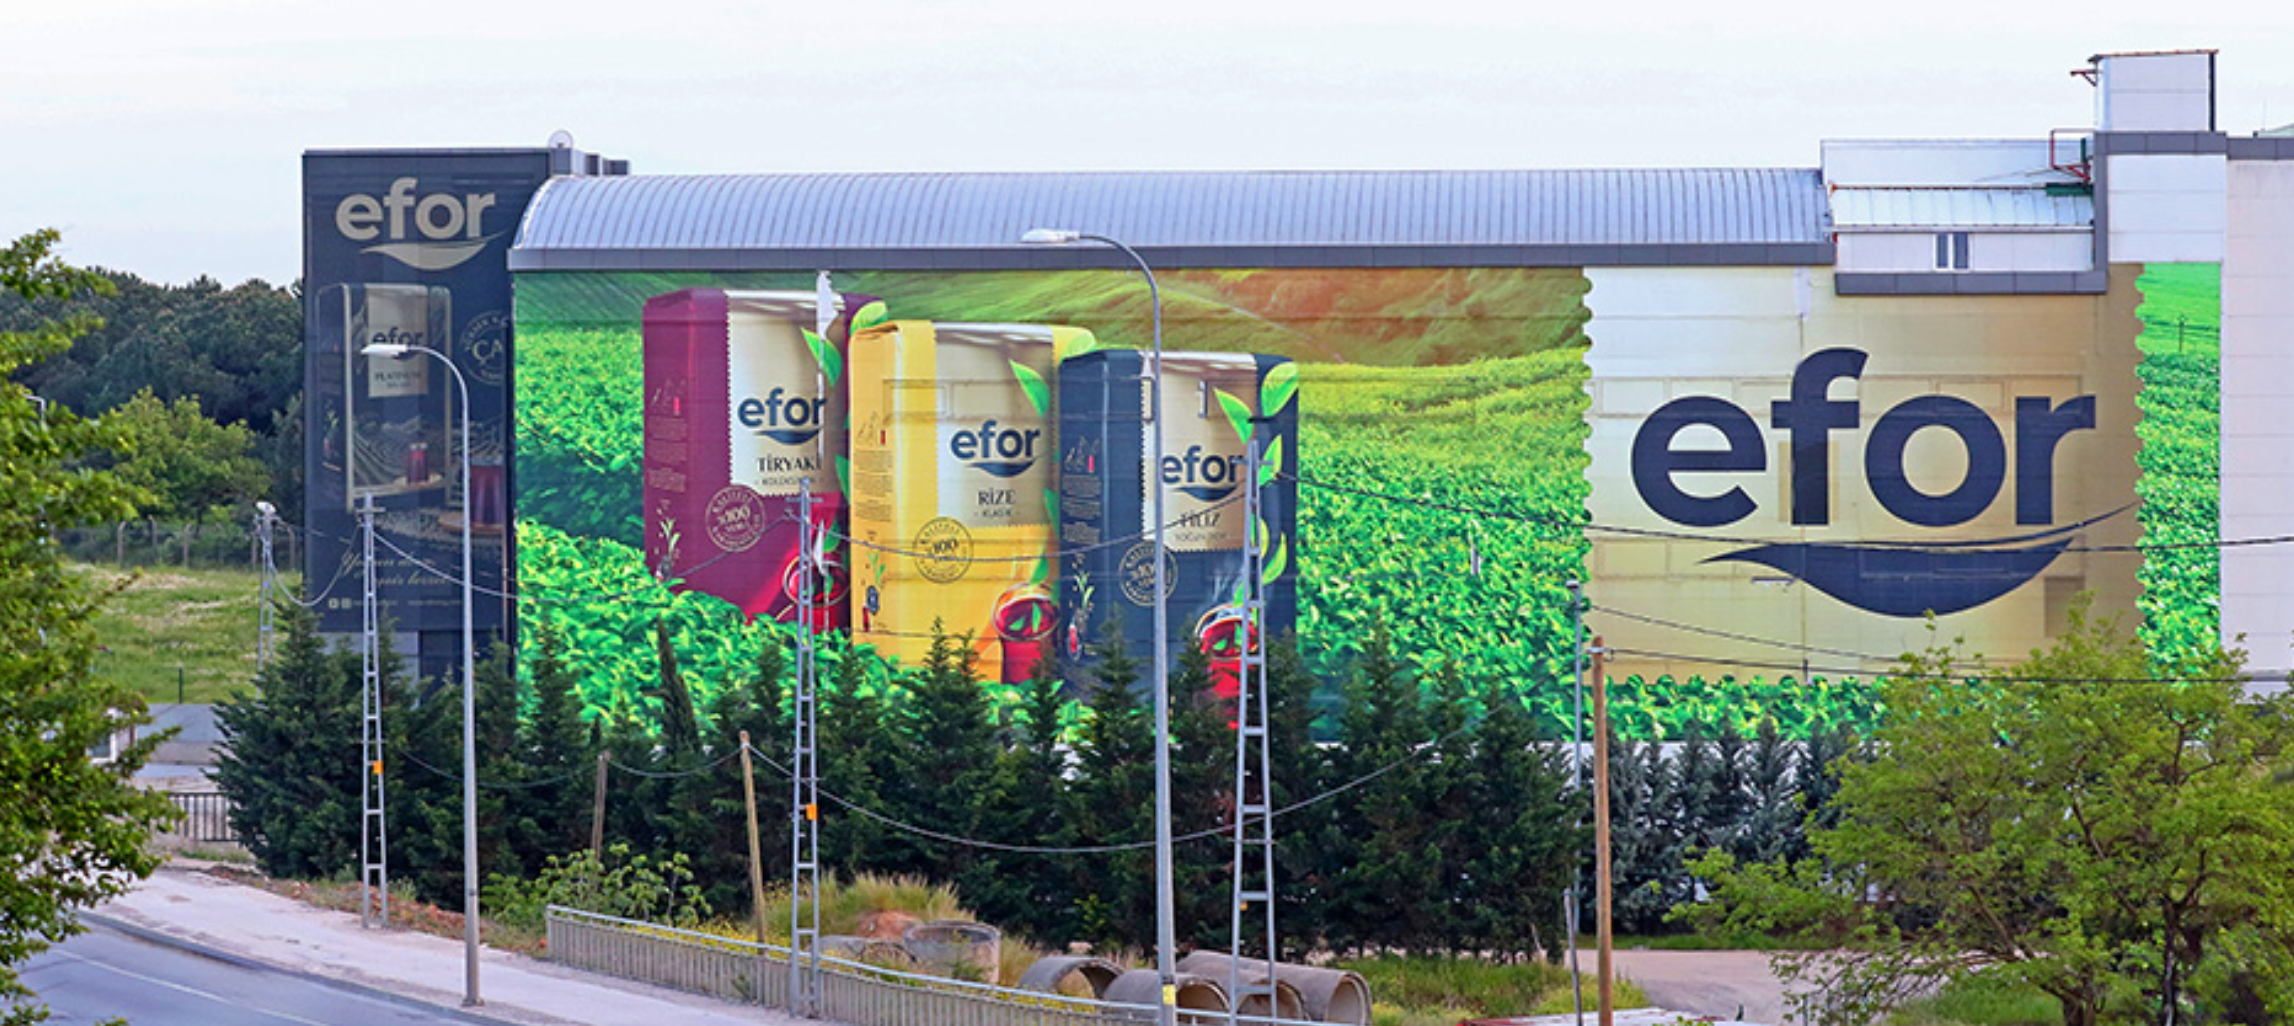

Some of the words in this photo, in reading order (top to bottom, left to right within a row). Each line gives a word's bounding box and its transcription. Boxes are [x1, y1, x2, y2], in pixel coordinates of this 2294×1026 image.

[335, 177, 496, 240] efor
[737, 387, 828, 427] efor
[950, 419, 1041, 459] efor
[1630, 346, 2097, 527] efor
[1160, 445, 1244, 484] efor
